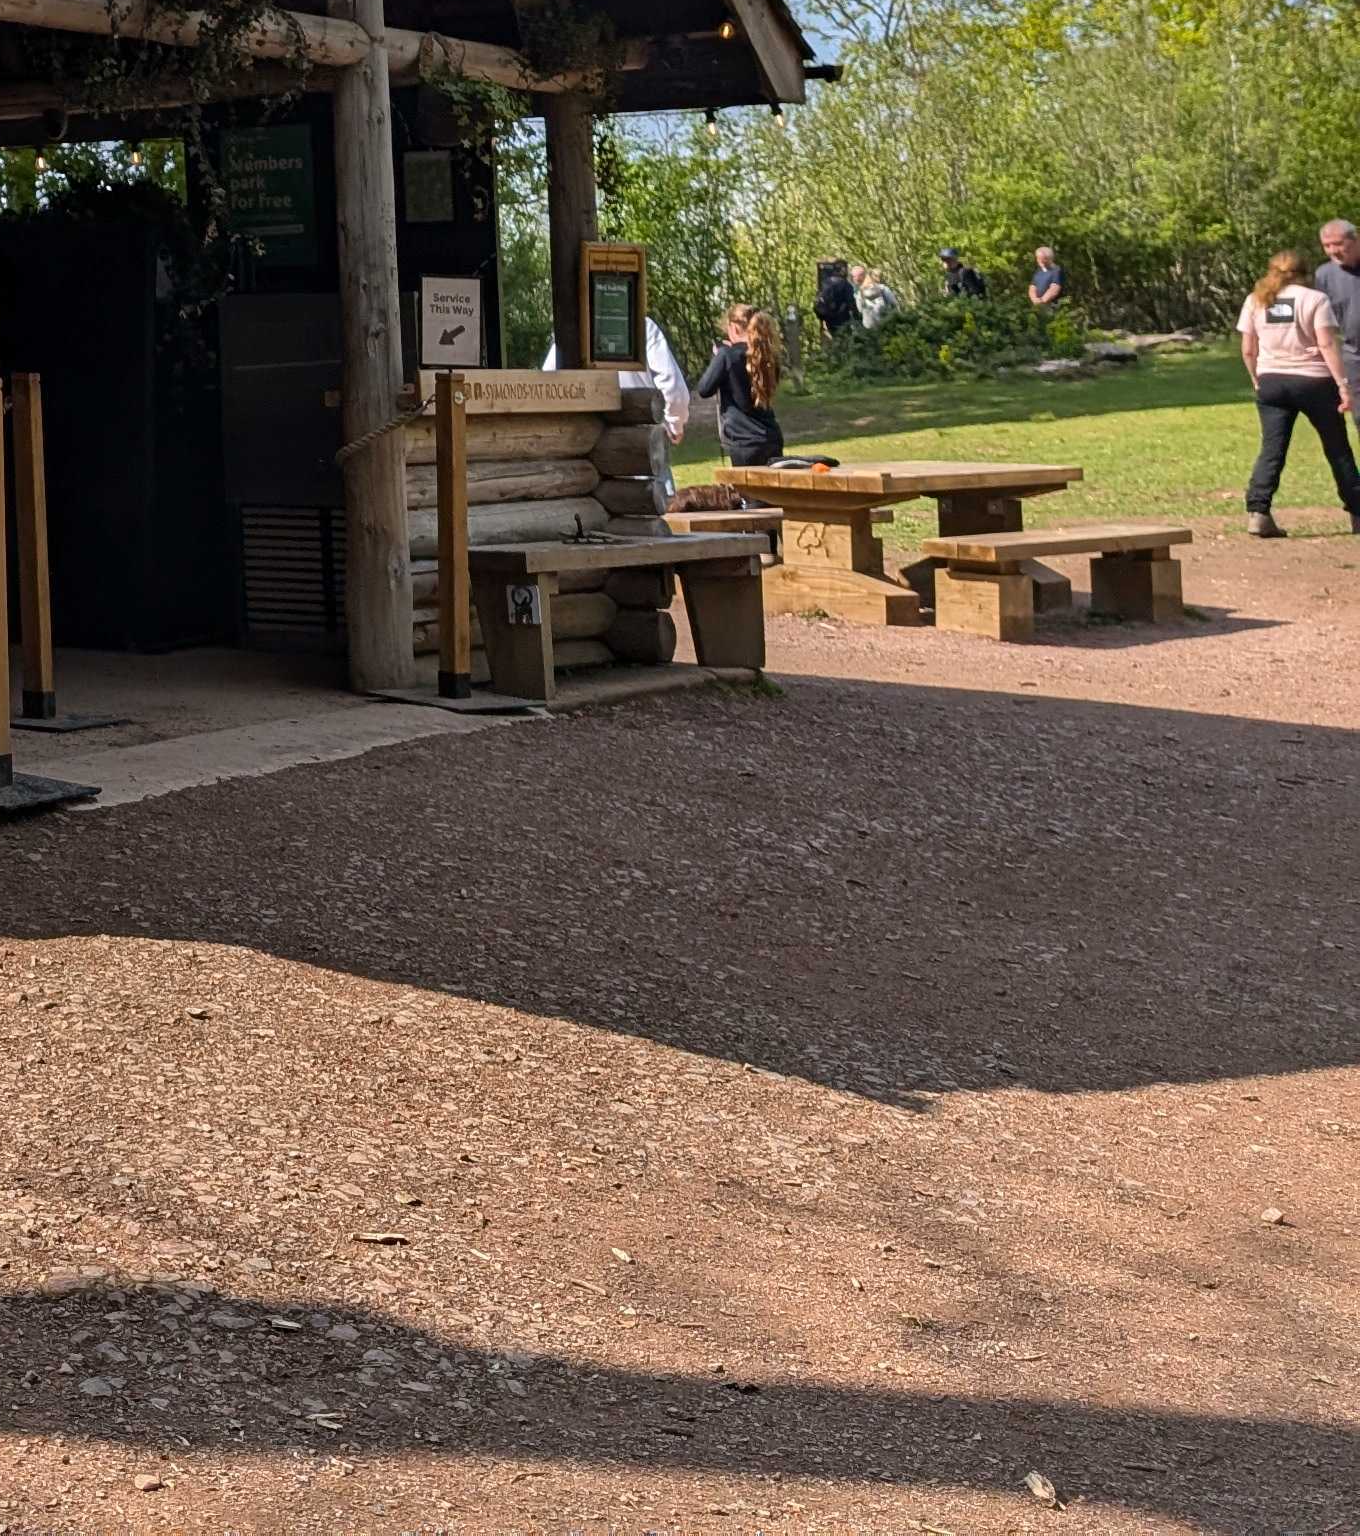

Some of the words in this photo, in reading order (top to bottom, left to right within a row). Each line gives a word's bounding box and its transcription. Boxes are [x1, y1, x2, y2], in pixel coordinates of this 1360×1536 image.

[230, 175, 265, 193] park
[433, 293, 471, 304] Service
[430, 304, 451, 314] This
[453, 305, 474, 317] Way
